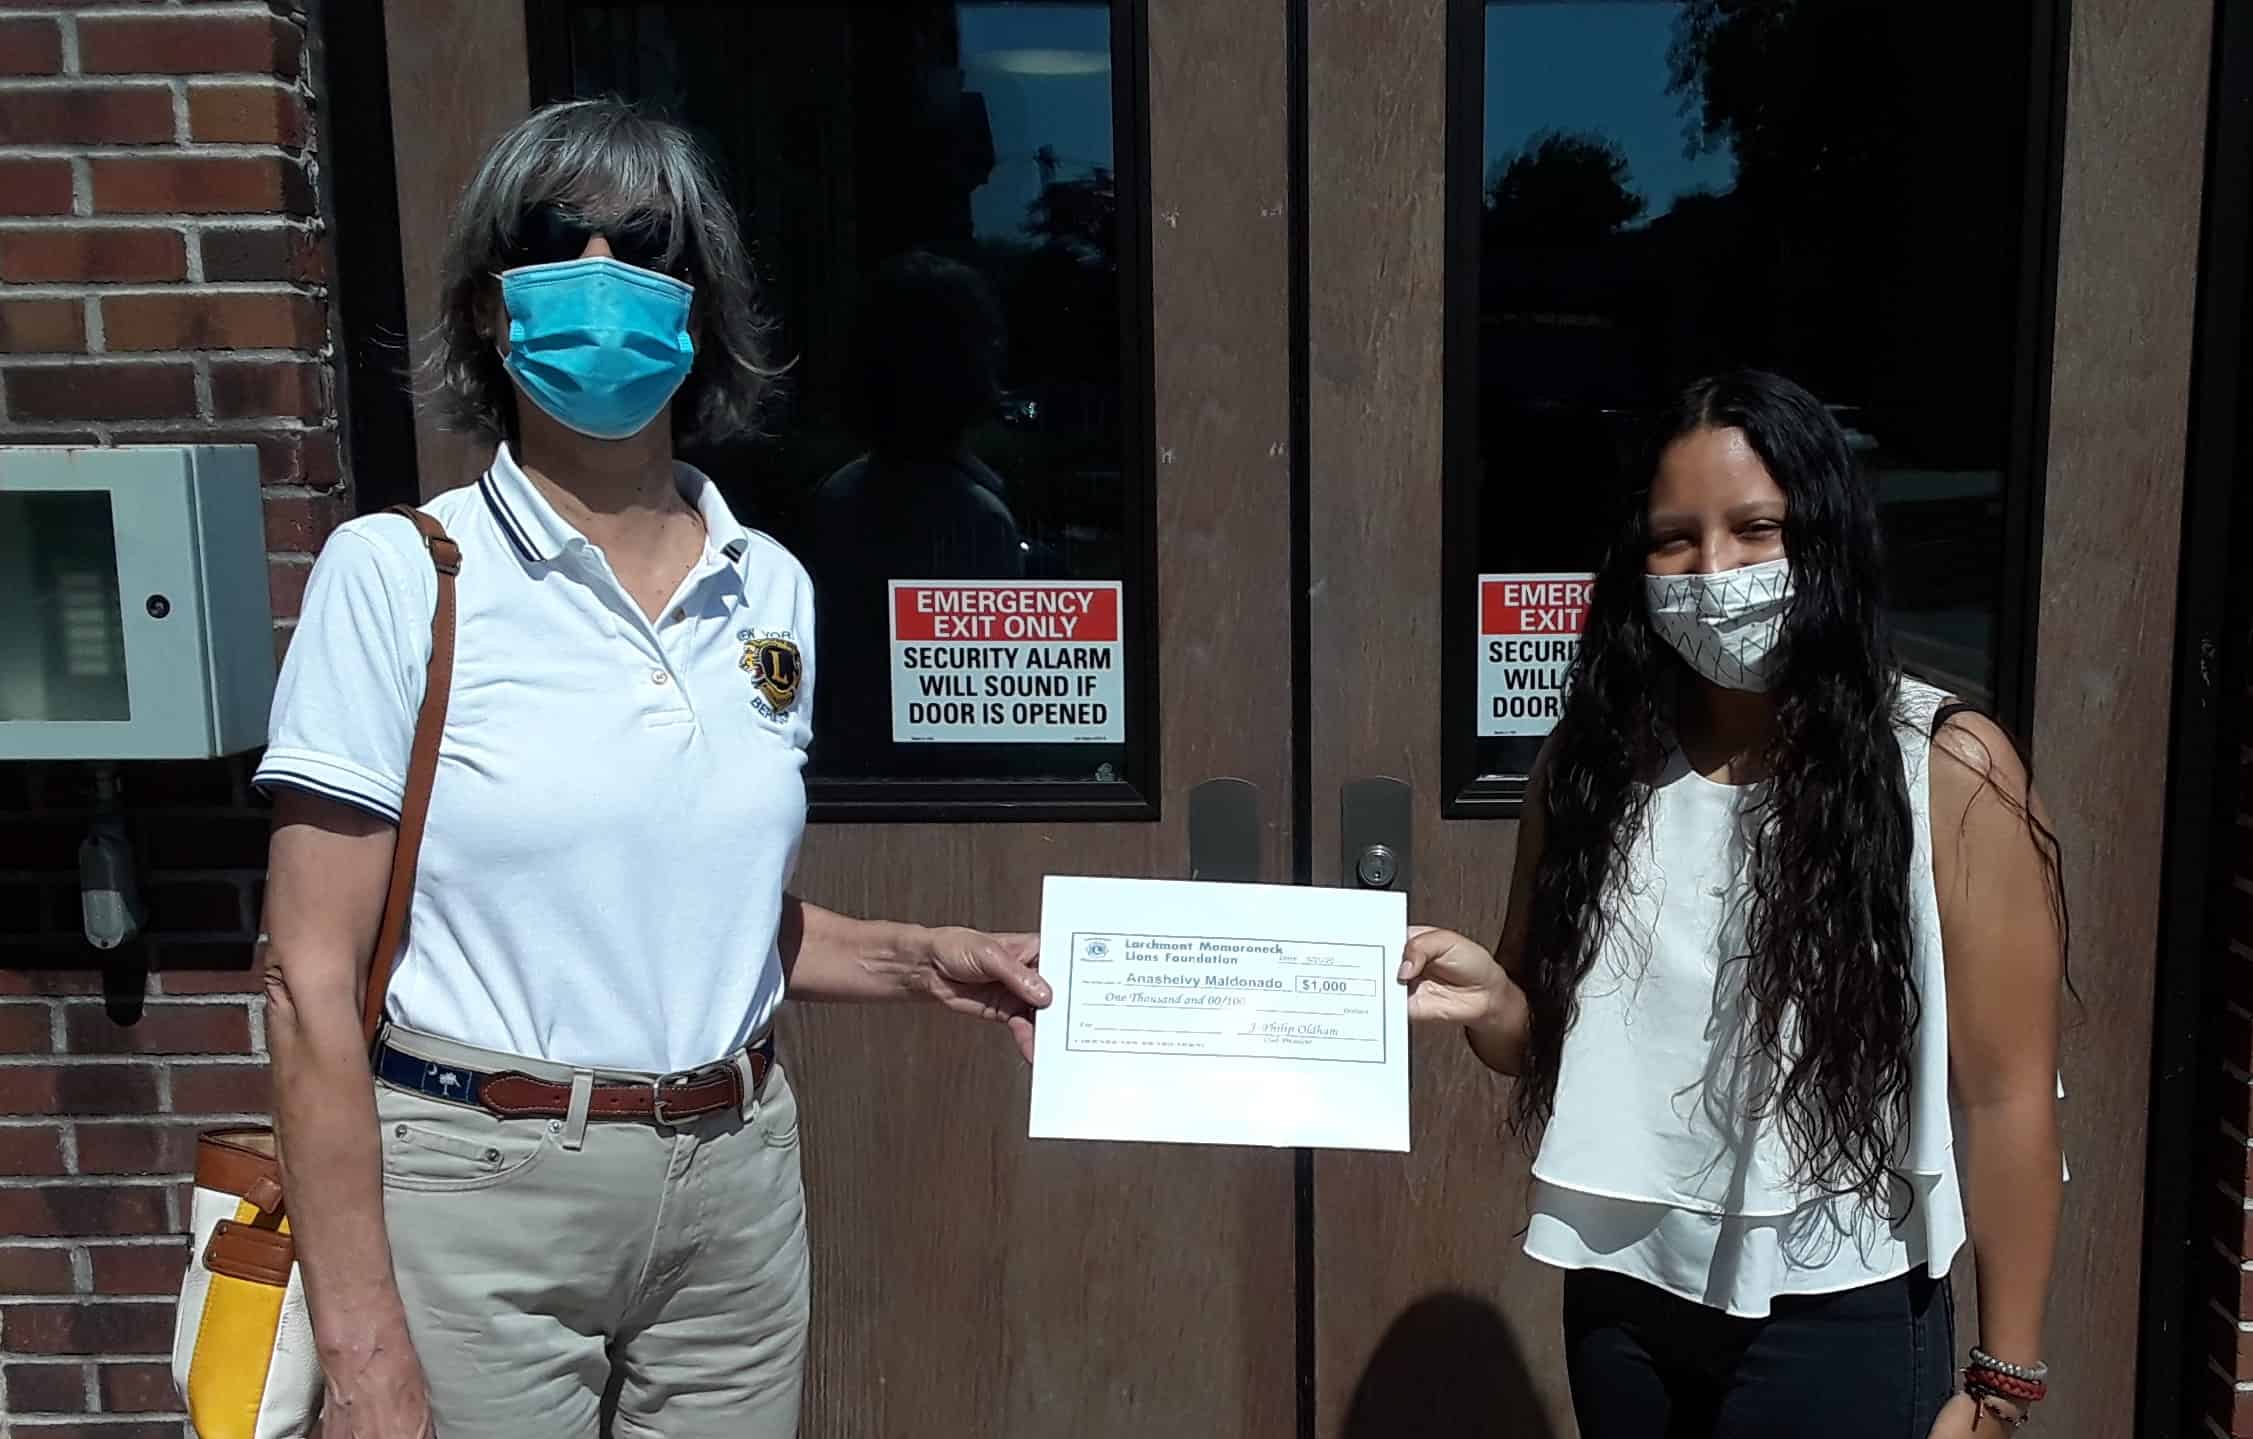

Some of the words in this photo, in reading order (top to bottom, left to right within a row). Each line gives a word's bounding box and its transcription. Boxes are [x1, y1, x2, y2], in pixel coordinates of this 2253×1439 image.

[916, 591, 1094, 614] EMERGENCY
[933, 616, 997, 638] EXIT
[1004, 616, 1078, 638] ONLY
[1519, 608, 1583, 631] EXIT
[903, 647, 1020, 669] SECURITY
[1026, 647, 1112, 669] ALARM
[919, 675, 978, 697] WILL
[984, 675, 1069, 697] SOUND
[1077, 675, 1097, 696] IF
[1503, 668, 1563, 690] WILL
[909, 702, 976, 724] DOOR
[983, 702, 1005, 724] IS
[1012, 702, 1107, 724] OPENED
[1492, 696, 1559, 718] DOOR
[1124, 938, 1193, 951] Larchmont
[1199, 941, 1284, 954] Mamaroneck
[1125, 951, 1159, 962] Lions
[1165, 953, 1238, 965] Foundation
[1204, 975, 1283, 989] Maldonado
[1302, 979, 1347, 993] $1,000
